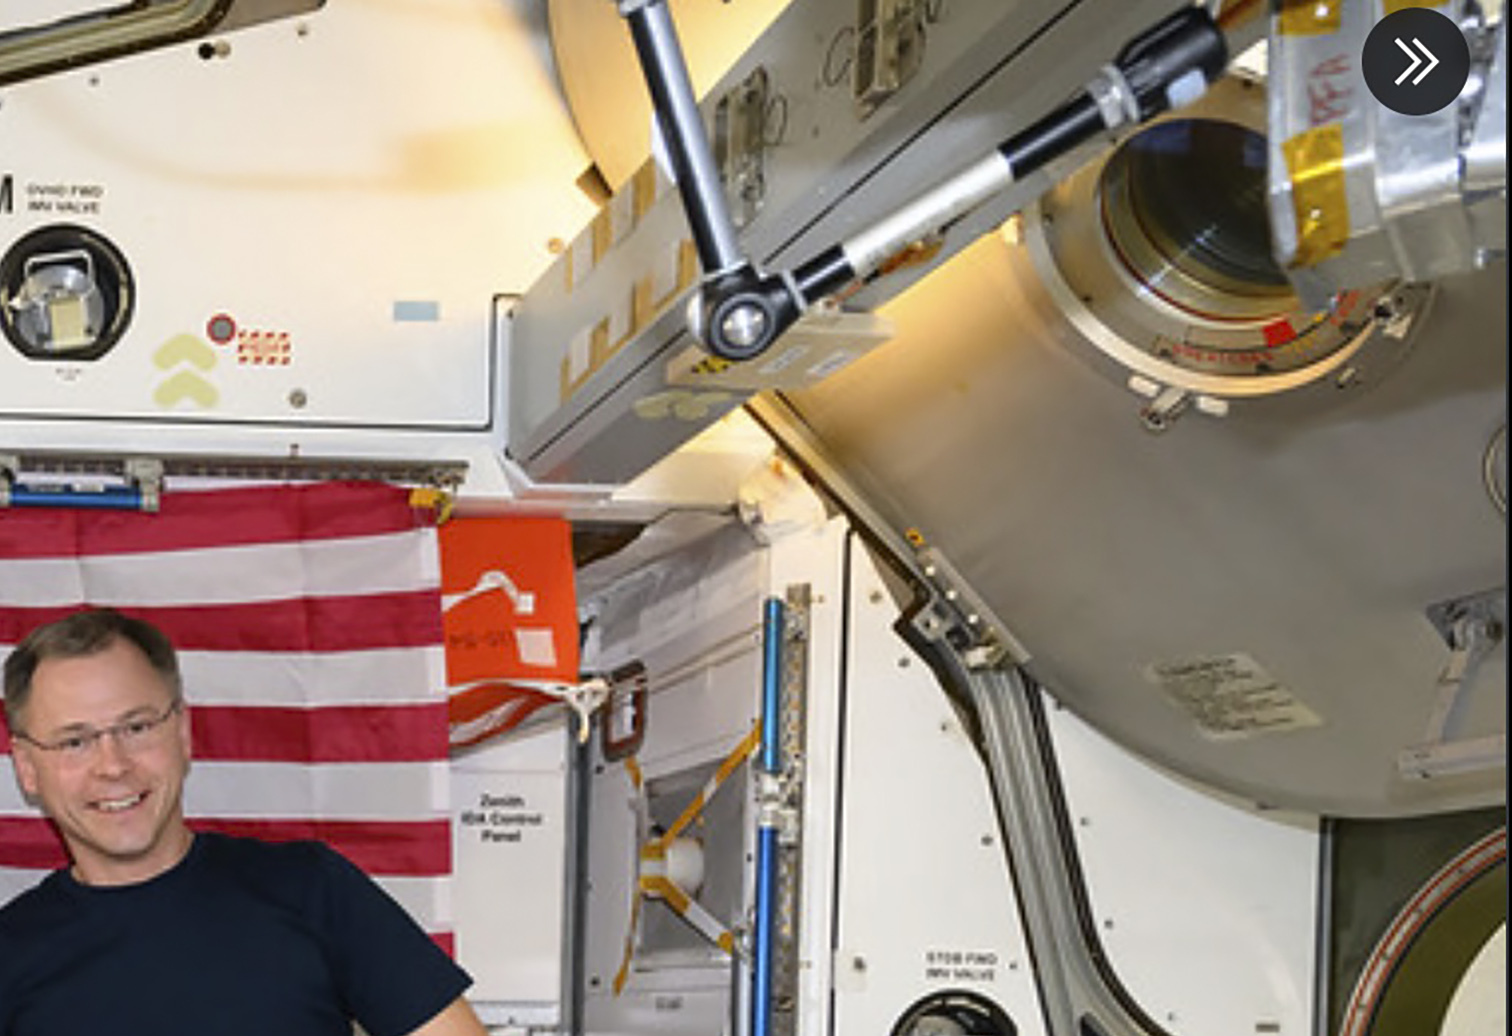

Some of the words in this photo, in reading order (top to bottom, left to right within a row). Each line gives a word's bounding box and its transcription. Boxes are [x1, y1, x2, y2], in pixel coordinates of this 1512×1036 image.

[480, 793, 526, 807] Zenith
[461, 811, 485, 826] IDA
[489, 811, 542, 826] Control
[481, 829, 522, 843] Panel
